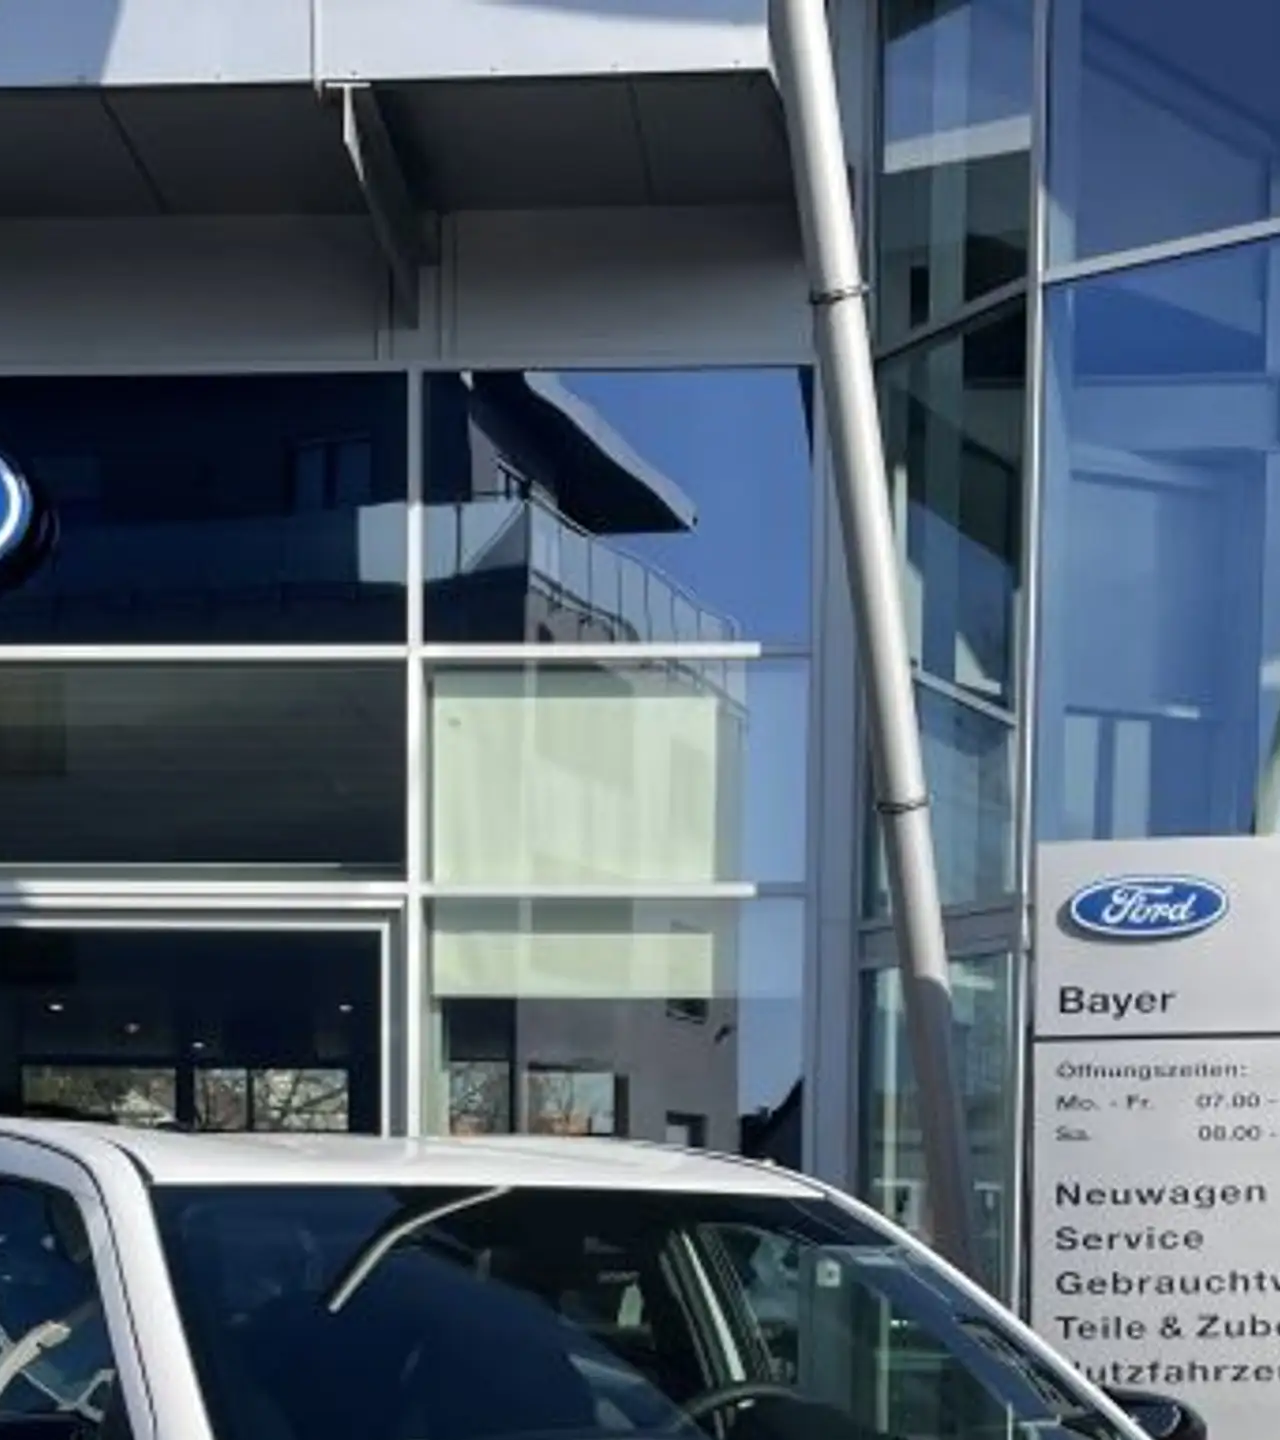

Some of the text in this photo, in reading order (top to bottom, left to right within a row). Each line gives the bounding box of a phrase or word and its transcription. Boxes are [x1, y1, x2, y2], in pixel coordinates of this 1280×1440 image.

[1100, 884, 1197, 925] Ford
[1058, 985, 1176, 1020] Bayer
[1056, 1182, 1267, 1209] Neuwagen
[1056, 1226, 1204, 1250] Service
[1055, 1315, 1145, 1340] Teile
[1159, 1315, 1183, 1339] &
